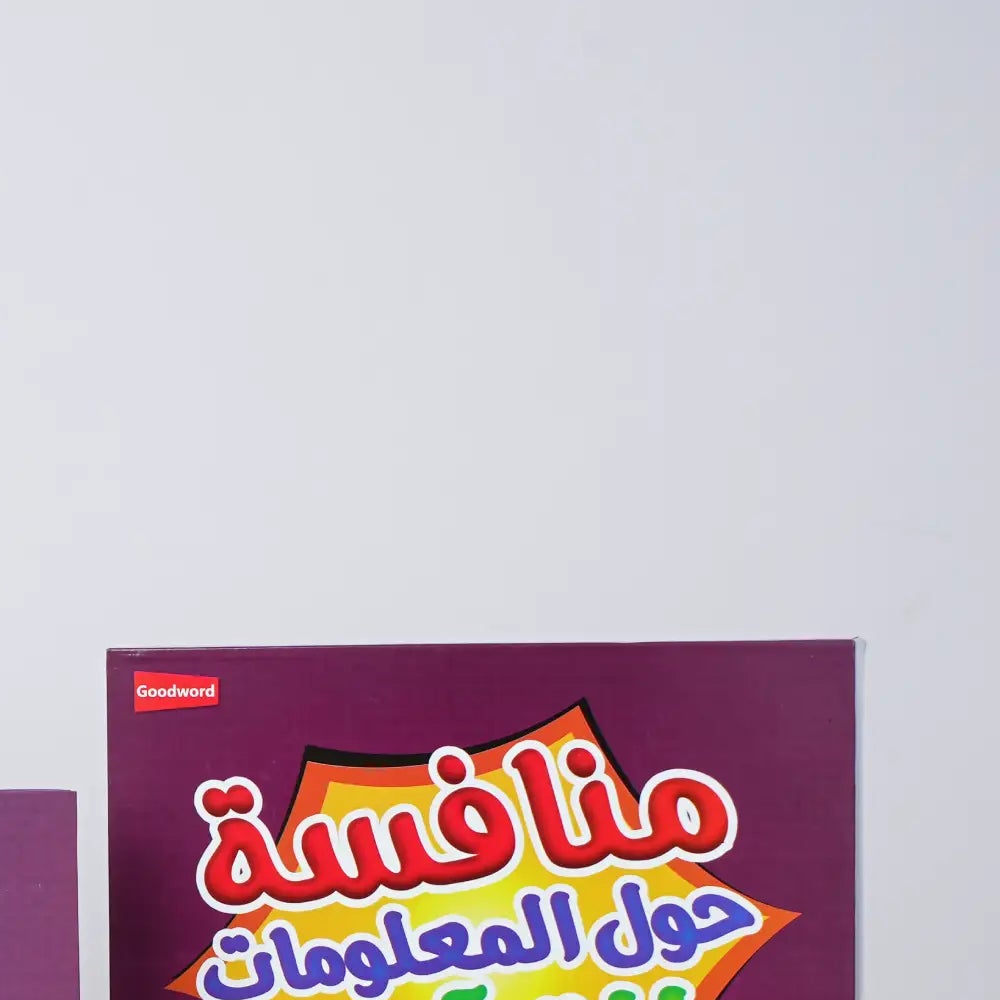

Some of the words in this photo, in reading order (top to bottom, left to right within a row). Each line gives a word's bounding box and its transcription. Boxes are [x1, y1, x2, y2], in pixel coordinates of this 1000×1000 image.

[136, 684, 215, 698] Goodword
[200, 744, 733, 908] منافسة
[594, 880, 758, 970] حول
